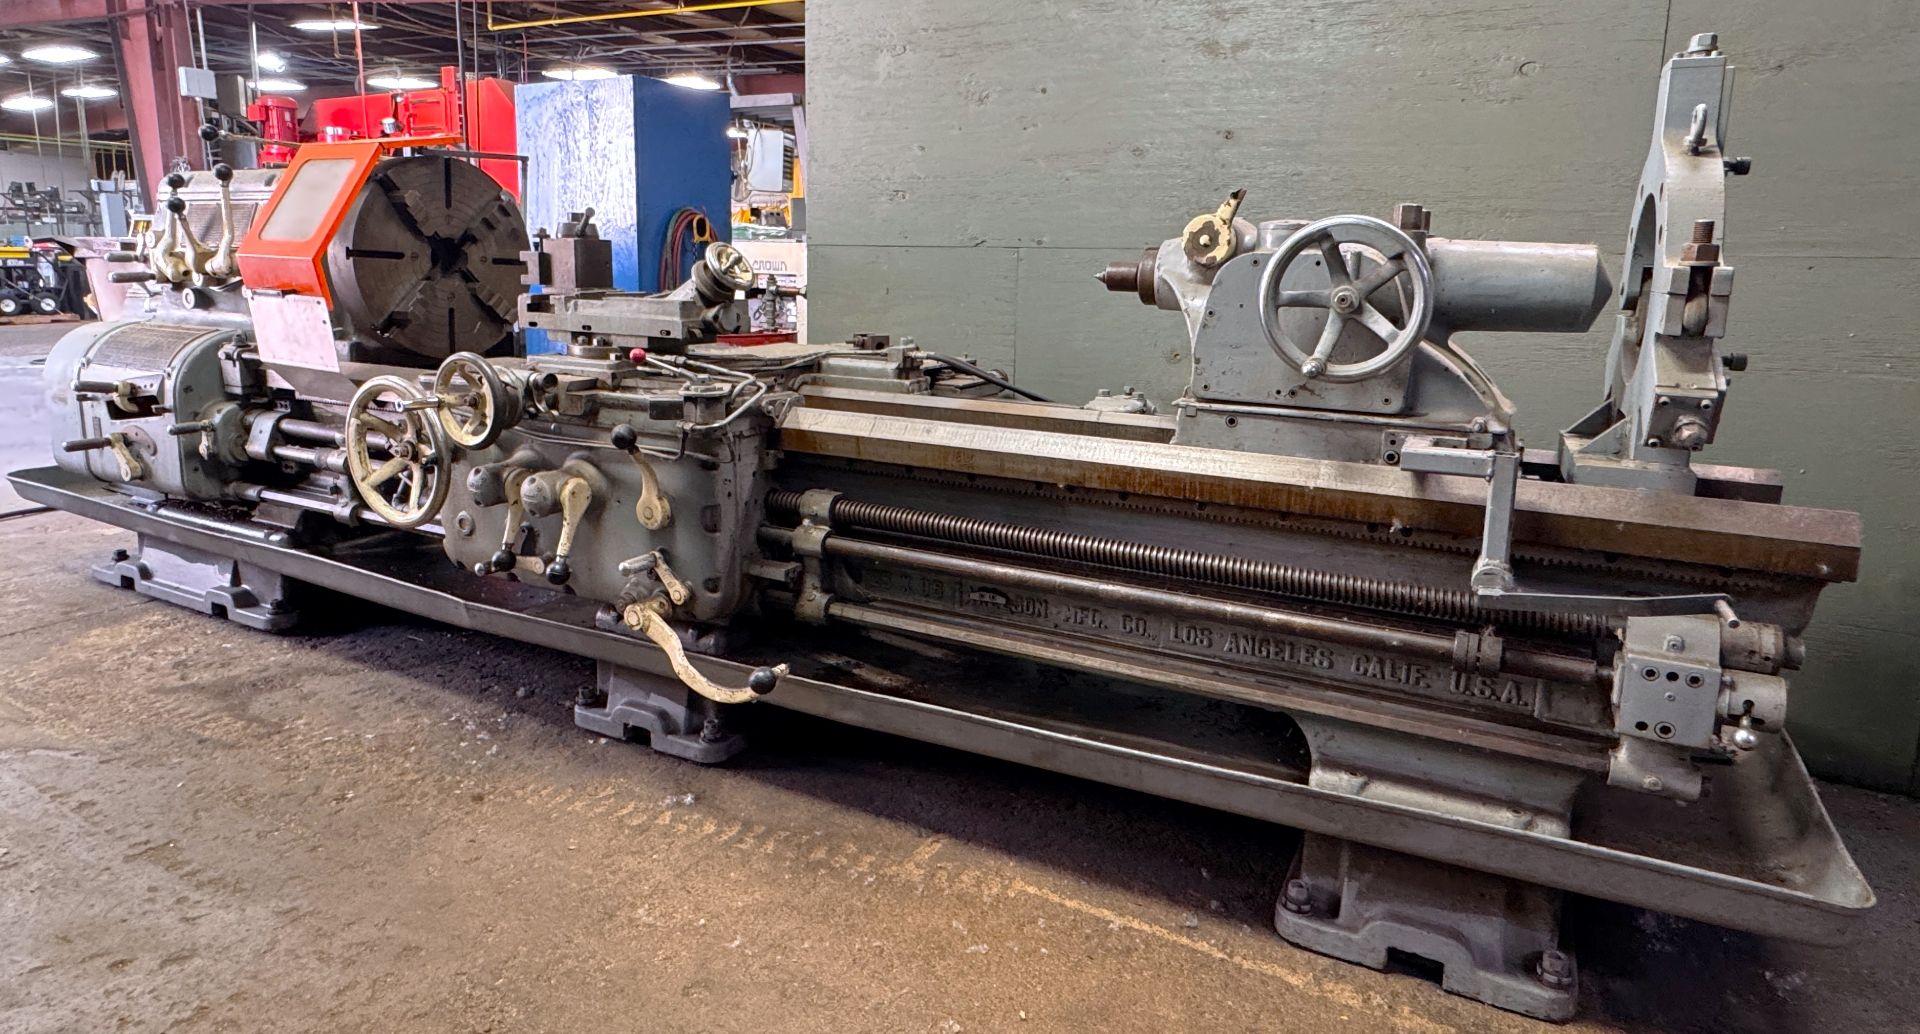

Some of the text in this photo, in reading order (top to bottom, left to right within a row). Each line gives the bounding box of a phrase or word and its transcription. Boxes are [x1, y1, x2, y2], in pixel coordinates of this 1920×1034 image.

[1169, 622, 1214, 649] LOS
[1223, 631, 1335, 671] ANGELES
[1450, 670, 1529, 707] U.S.A.
